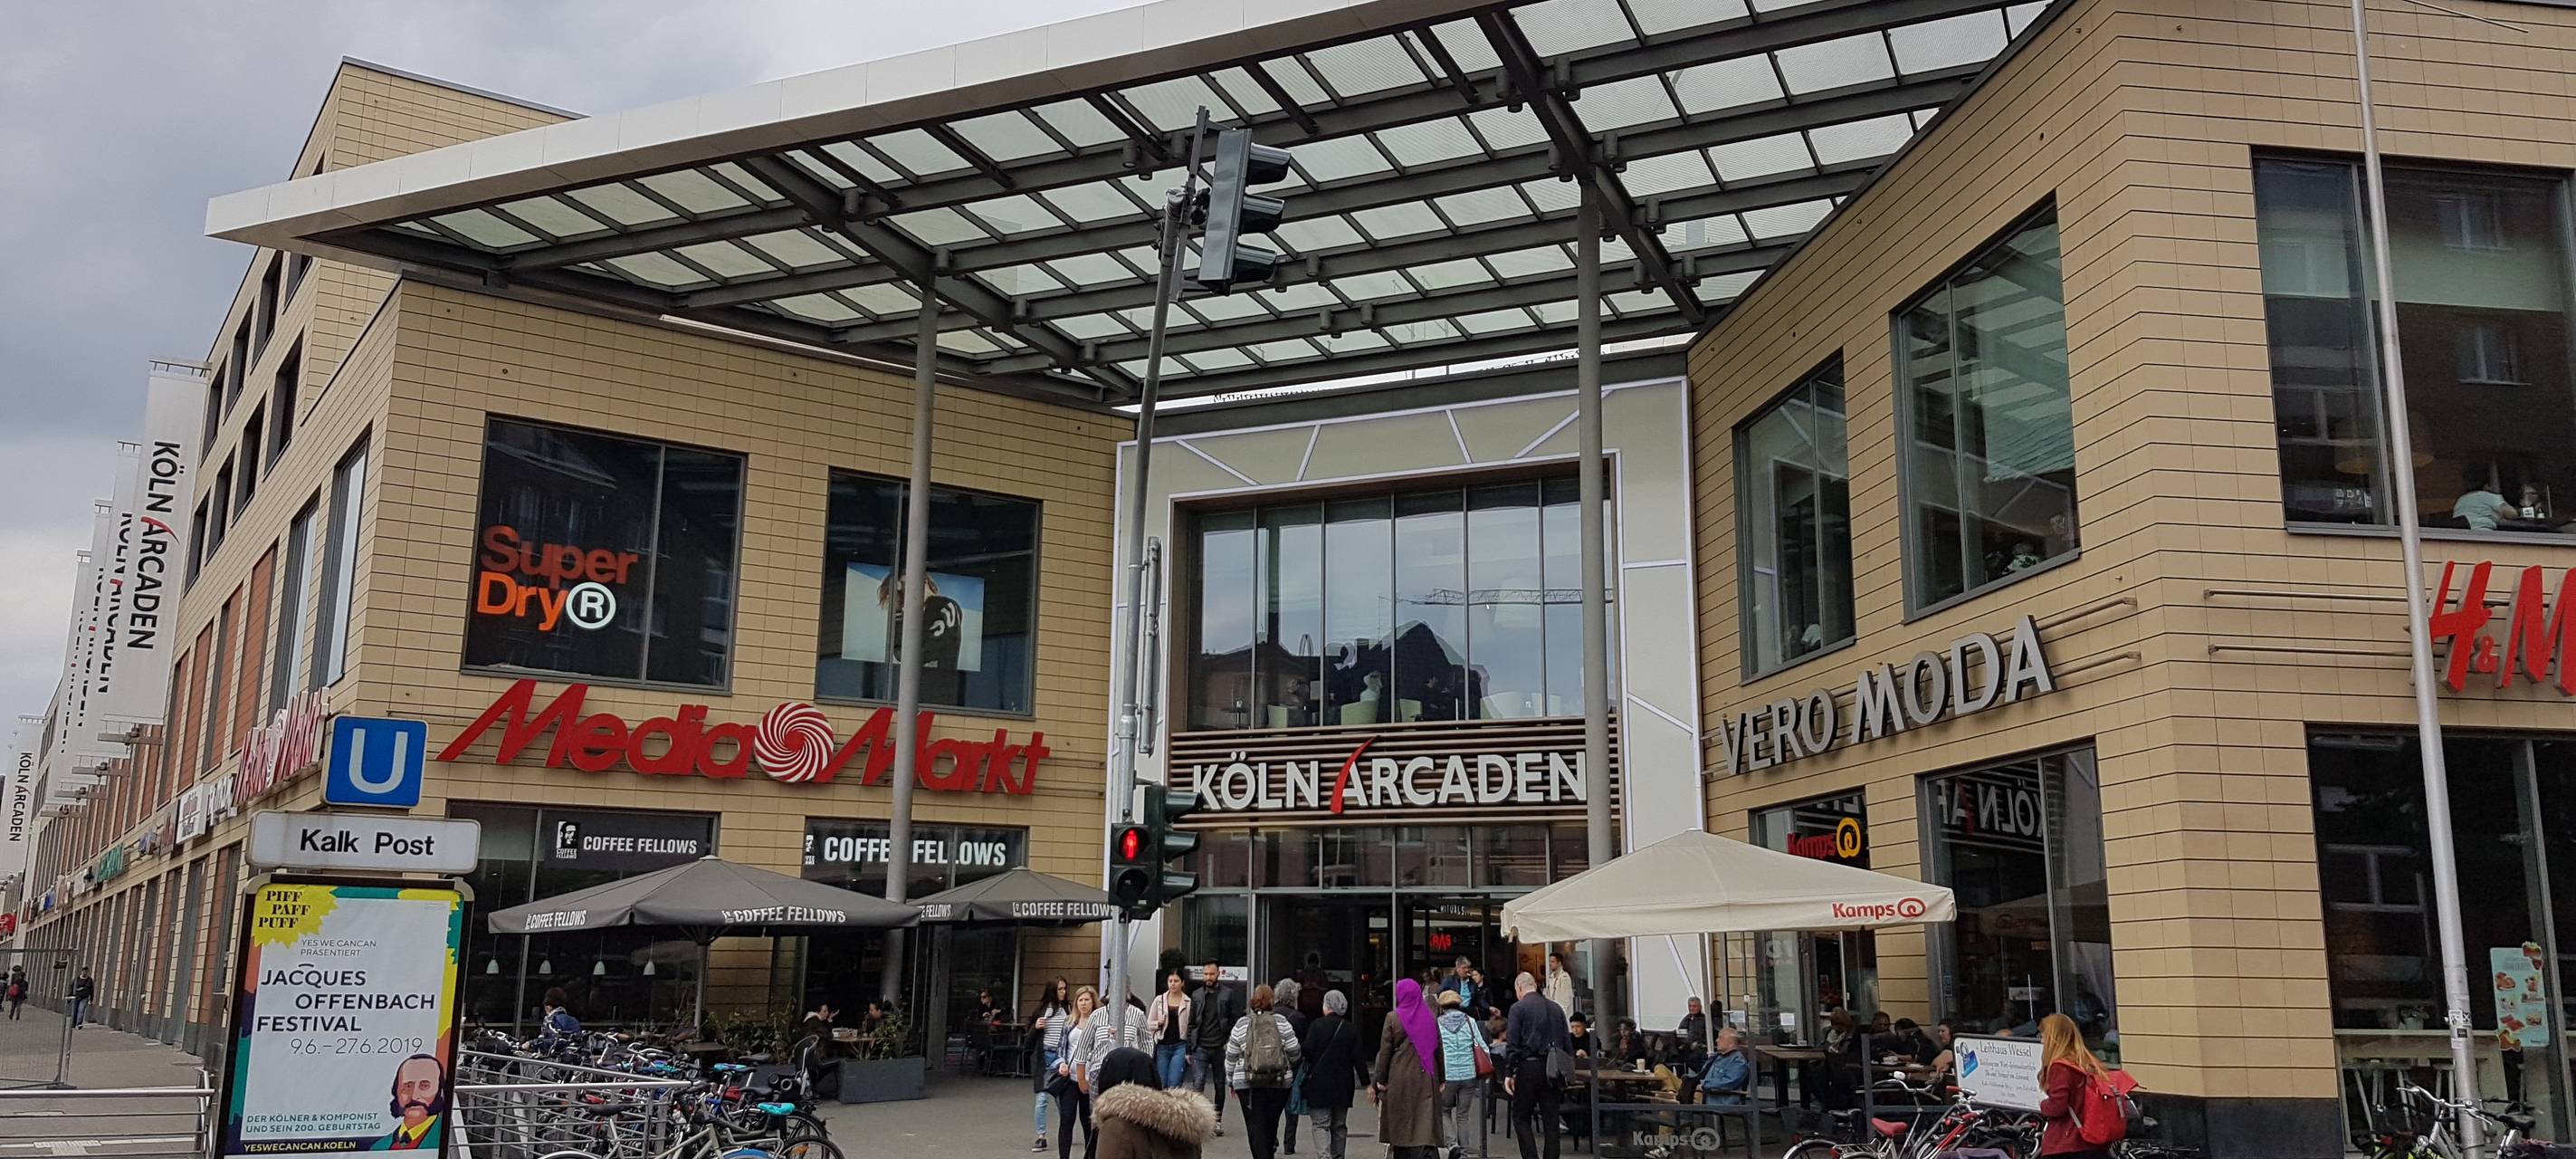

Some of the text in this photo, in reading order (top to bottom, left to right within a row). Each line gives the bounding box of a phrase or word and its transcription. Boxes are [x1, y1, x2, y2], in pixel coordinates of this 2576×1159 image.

[127, 441, 185, 649] KÖLN ARCADEN
[482, 524, 638, 589] Super
[2428, 560, 2576, 696] H&M
[1720, 614, 2057, 776] VERO MODA
[435, 678, 1050, 795] Media Markt
[348, 728, 408, 794] U
[1193, 735, 1588, 814] KÖLN ARCADEN
[8, 752, 34, 842] KÖLN ARCADEN
[300, 828, 434, 856] Kalk Post
[583, 835, 697, 855] COFFEE FELLOWS
[824, 836, 1007, 867] COFFE FELOWS
[266, 890, 303, 902] PIFF
[272, 904, 311, 915] PAFF
[733, 905, 846, 923] COFFEE FELLOWS
[925, 904, 951, 917] FELLOWS
[1022, 902, 1064, 915] COFFEE
[1832, 901, 1895, 921] Kamps
[258, 916, 299, 928] PUFF
[530, 909, 587, 929] COFFEE FELLOWS
[301, 938, 377, 948] YES WE CANCAN
[261, 970, 367, 989] JACQUES
[295, 994, 435, 1010] OFFENBACH
[257, 1016, 363, 1032] FESTIVAL
[246, 1115, 266, 1123] DER
[311, 1114, 318, 1122] &
[320, 1113, 378, 1121] KOMPONIST
[245, 1123, 381, 1133] UND SEIN 200. GEBURTSTAG
[243, 1141, 357, 1153] YESWECANCAN.KOELN
[1632, 1130, 1688, 1147] Kamps
